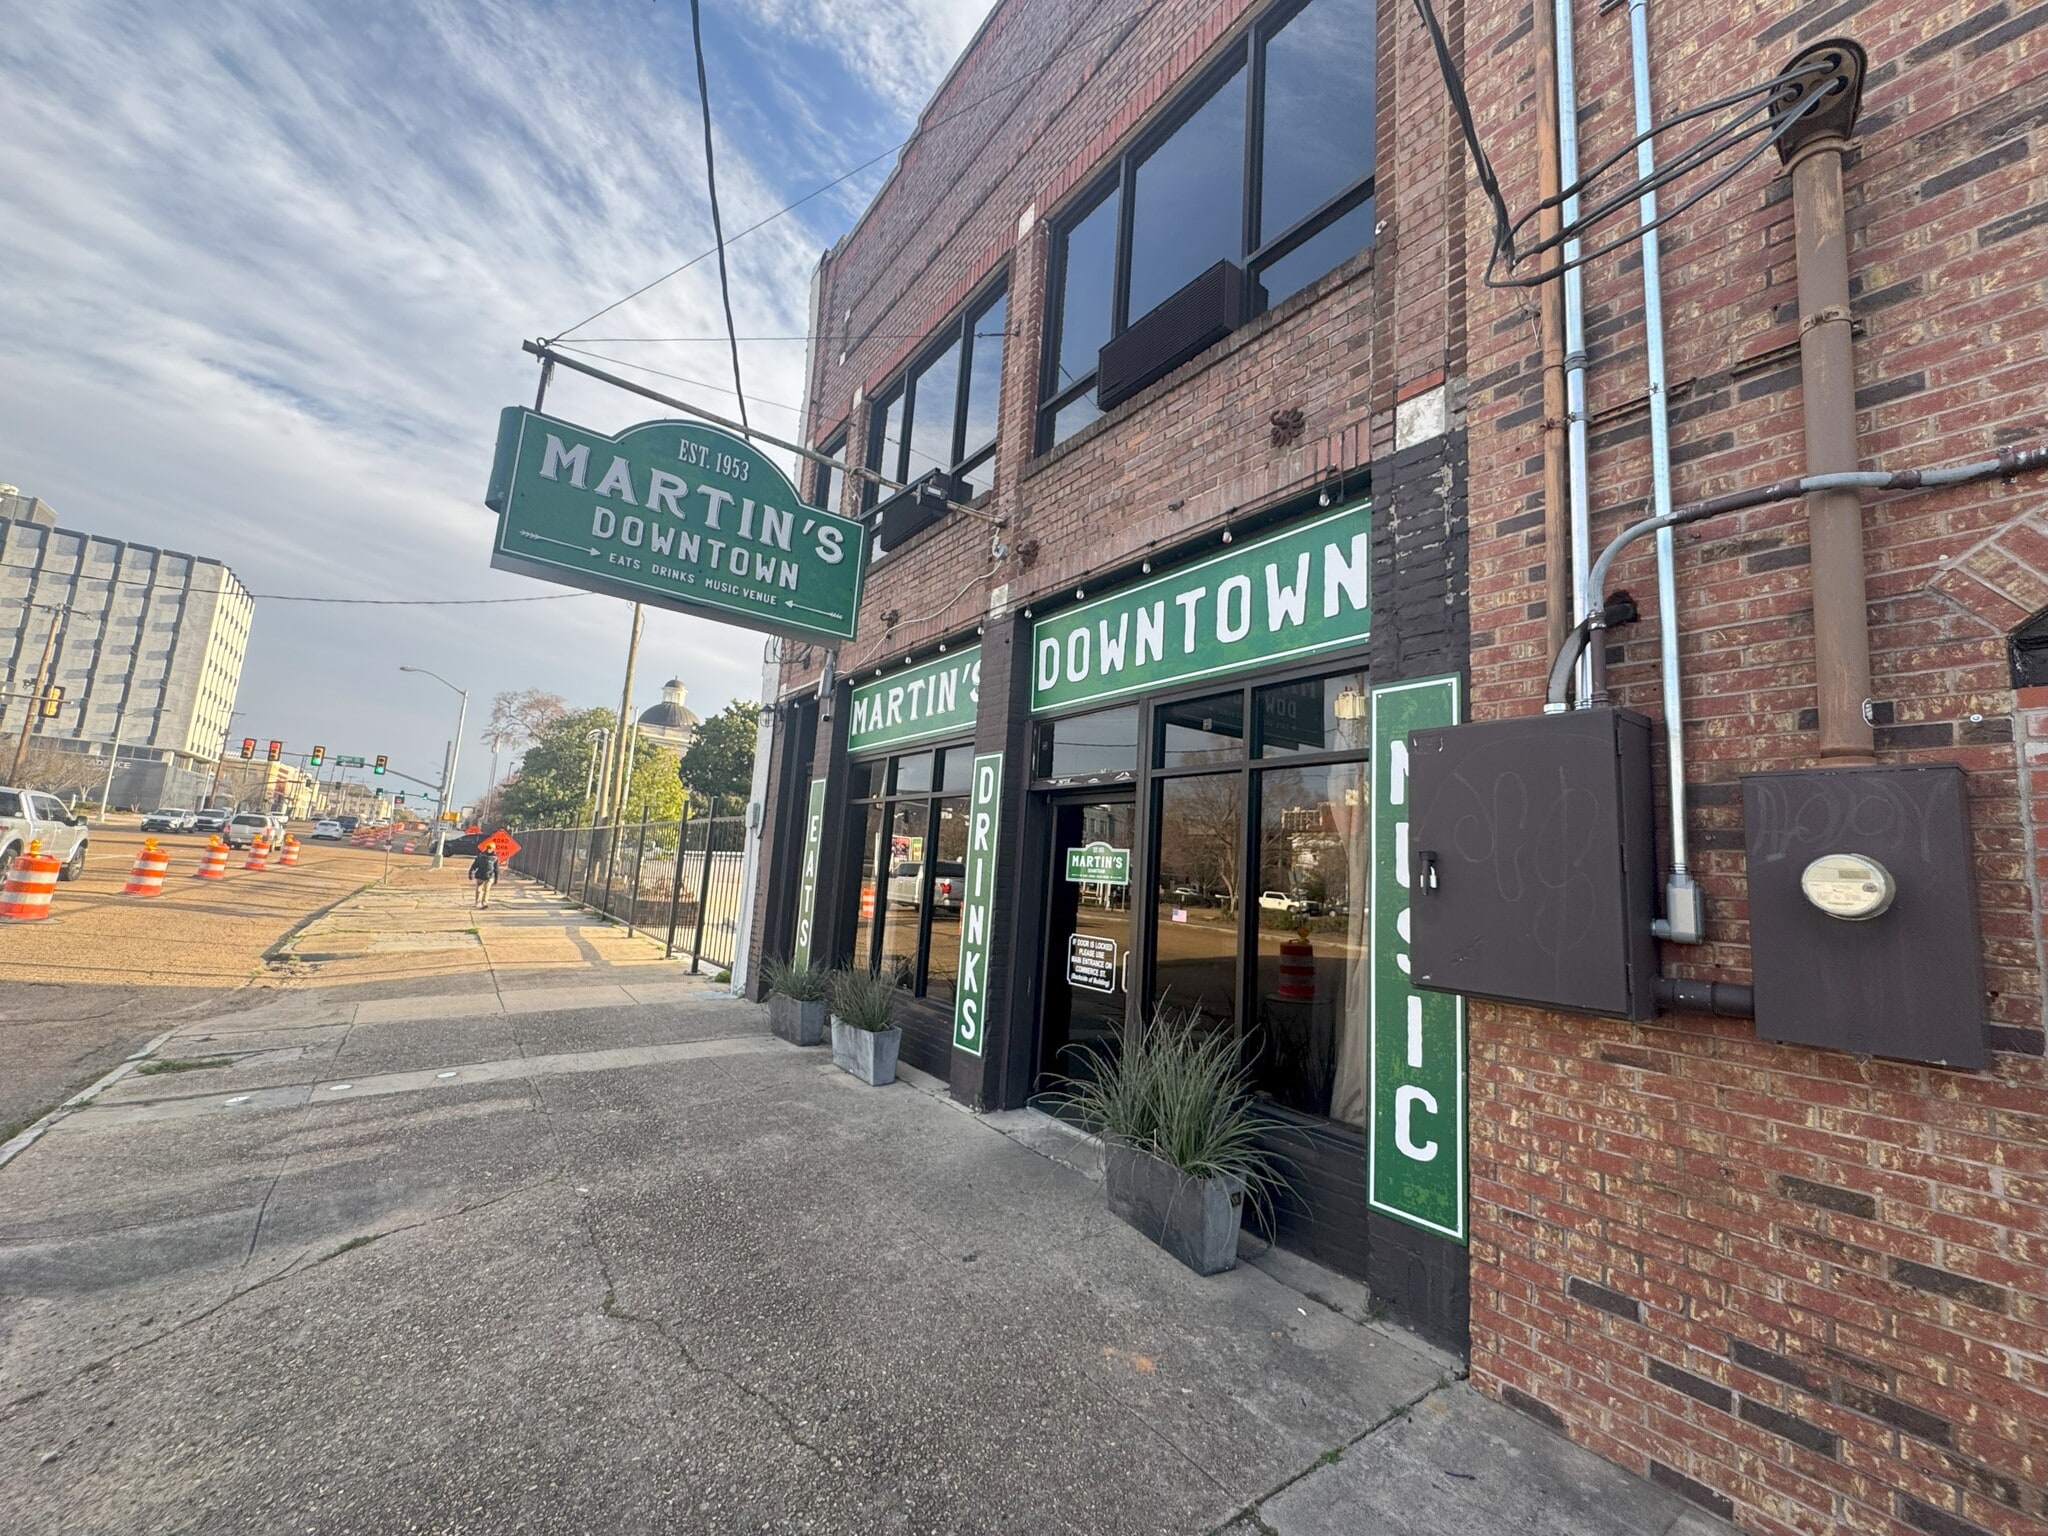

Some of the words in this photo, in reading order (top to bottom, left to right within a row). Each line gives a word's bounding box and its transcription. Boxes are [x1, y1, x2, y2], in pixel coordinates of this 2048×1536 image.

[539, 433, 844, 564] MARTIN'S
[678, 438, 710, 469] EST.
[716, 452, 750, 482] 1953
[591, 505, 799, 591] DOWNTOWN
[608, 552, 641, 570] EATS
[651, 563, 695, 584] DRINKS
[705, 577, 739, 596] MUSIC
[742, 588, 778, 605] VENUE
[1037, 532, 1368, 691] DOWNTOWN
[799, 814, 819, 948] EATS
[961, 766, 994, 1041] DRINKS
[1072, 855, 1123, 869] MARTIN'S
